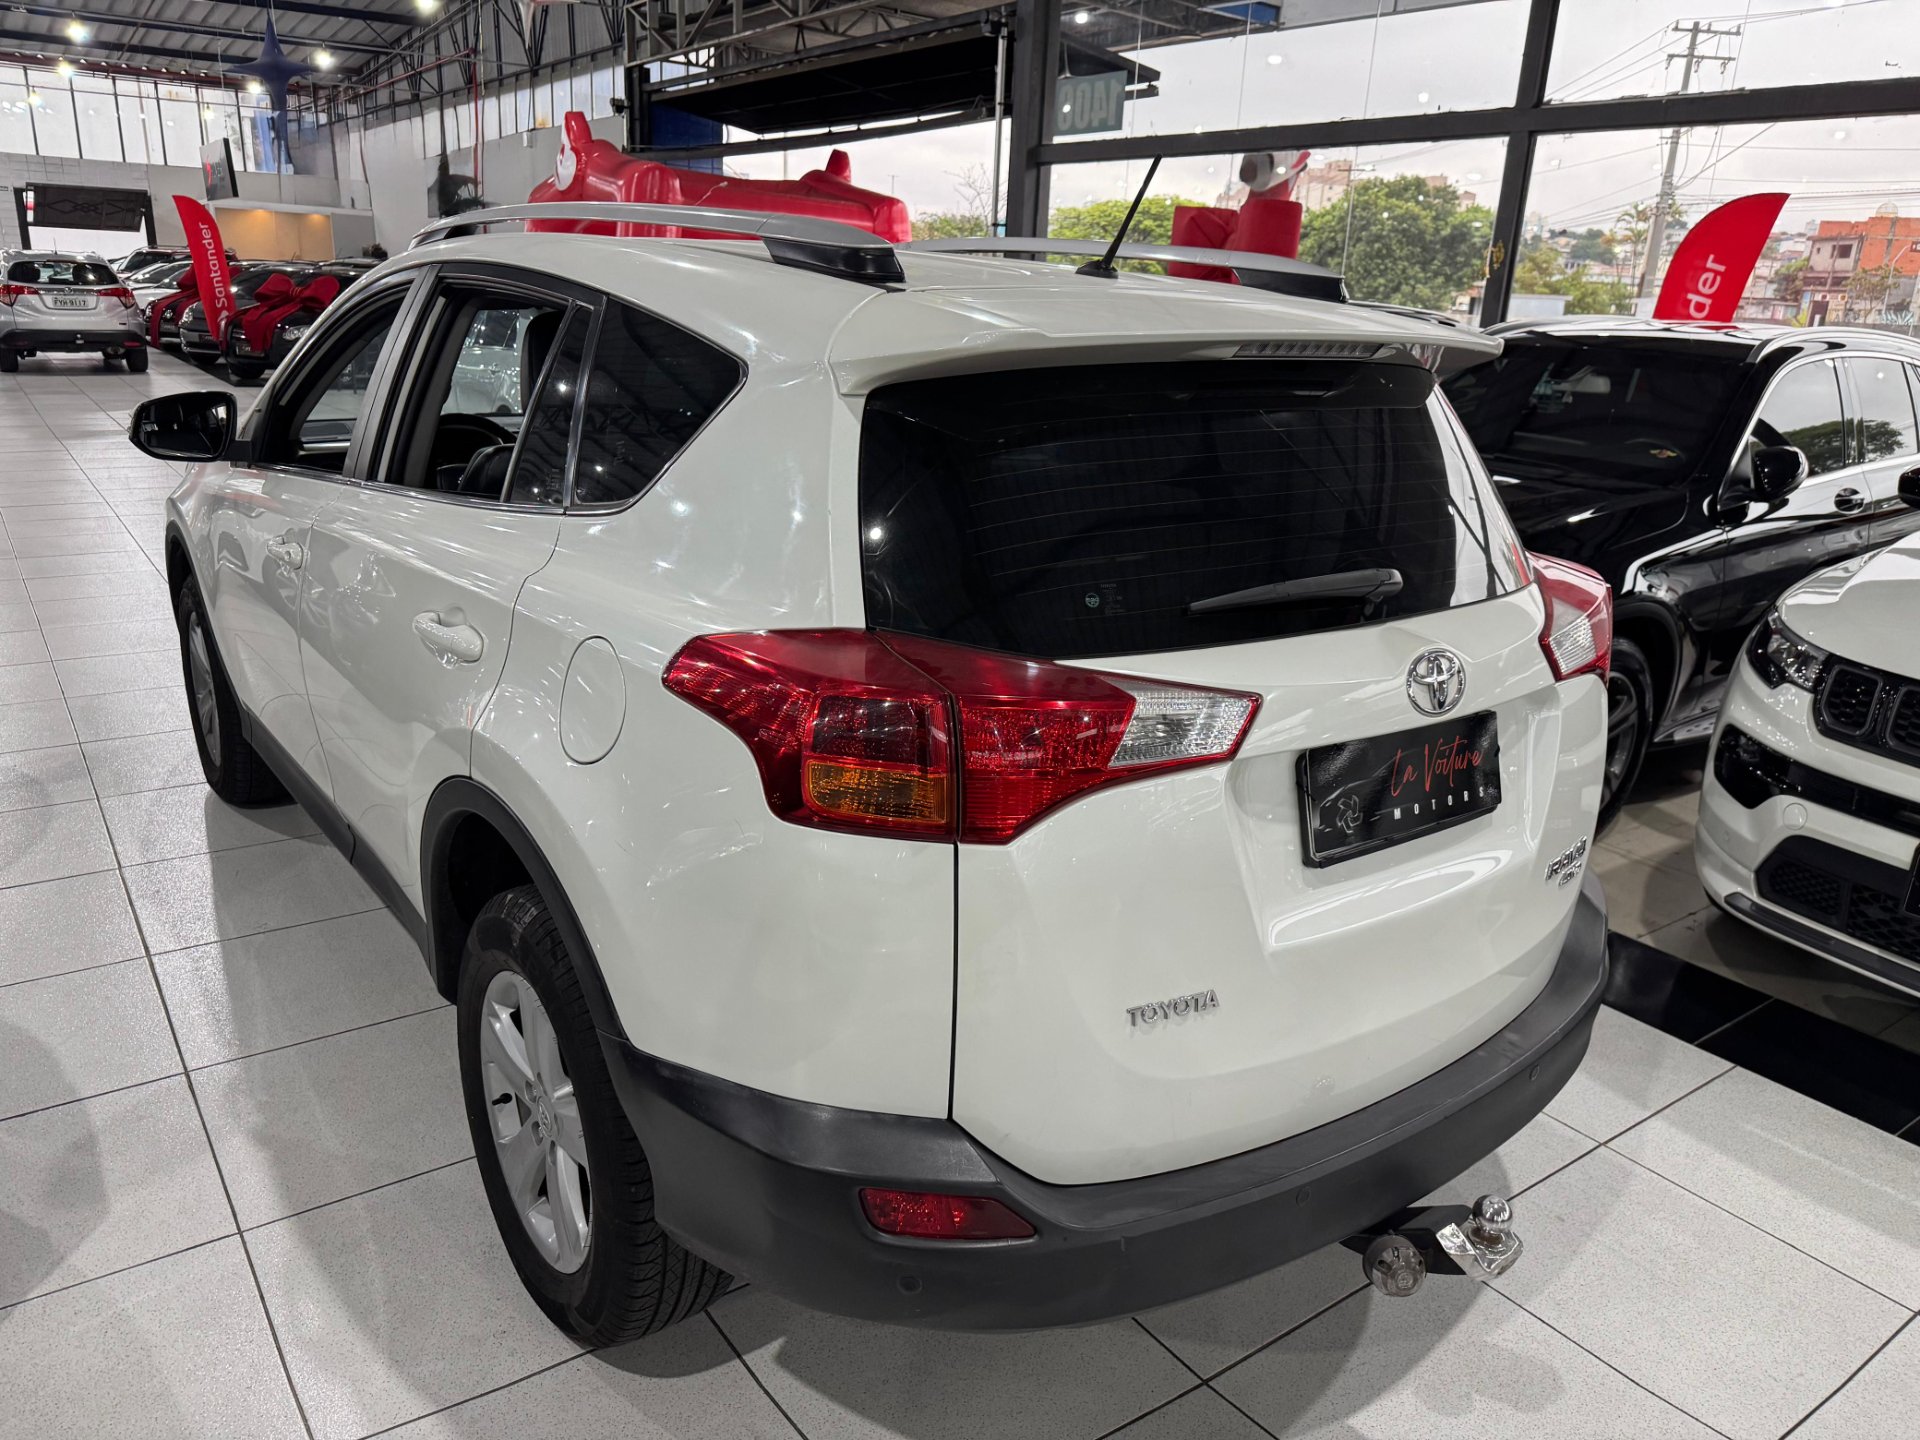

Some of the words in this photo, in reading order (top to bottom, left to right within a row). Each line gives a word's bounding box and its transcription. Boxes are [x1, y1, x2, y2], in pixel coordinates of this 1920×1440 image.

[199, 222, 228, 308] Santander
[1391, 748, 1418, 797] La
[1424, 735, 1484, 792] Voiture
[1393, 786, 1484, 820] MOTORS
[1126, 989, 1220, 1027] TOYOTA
